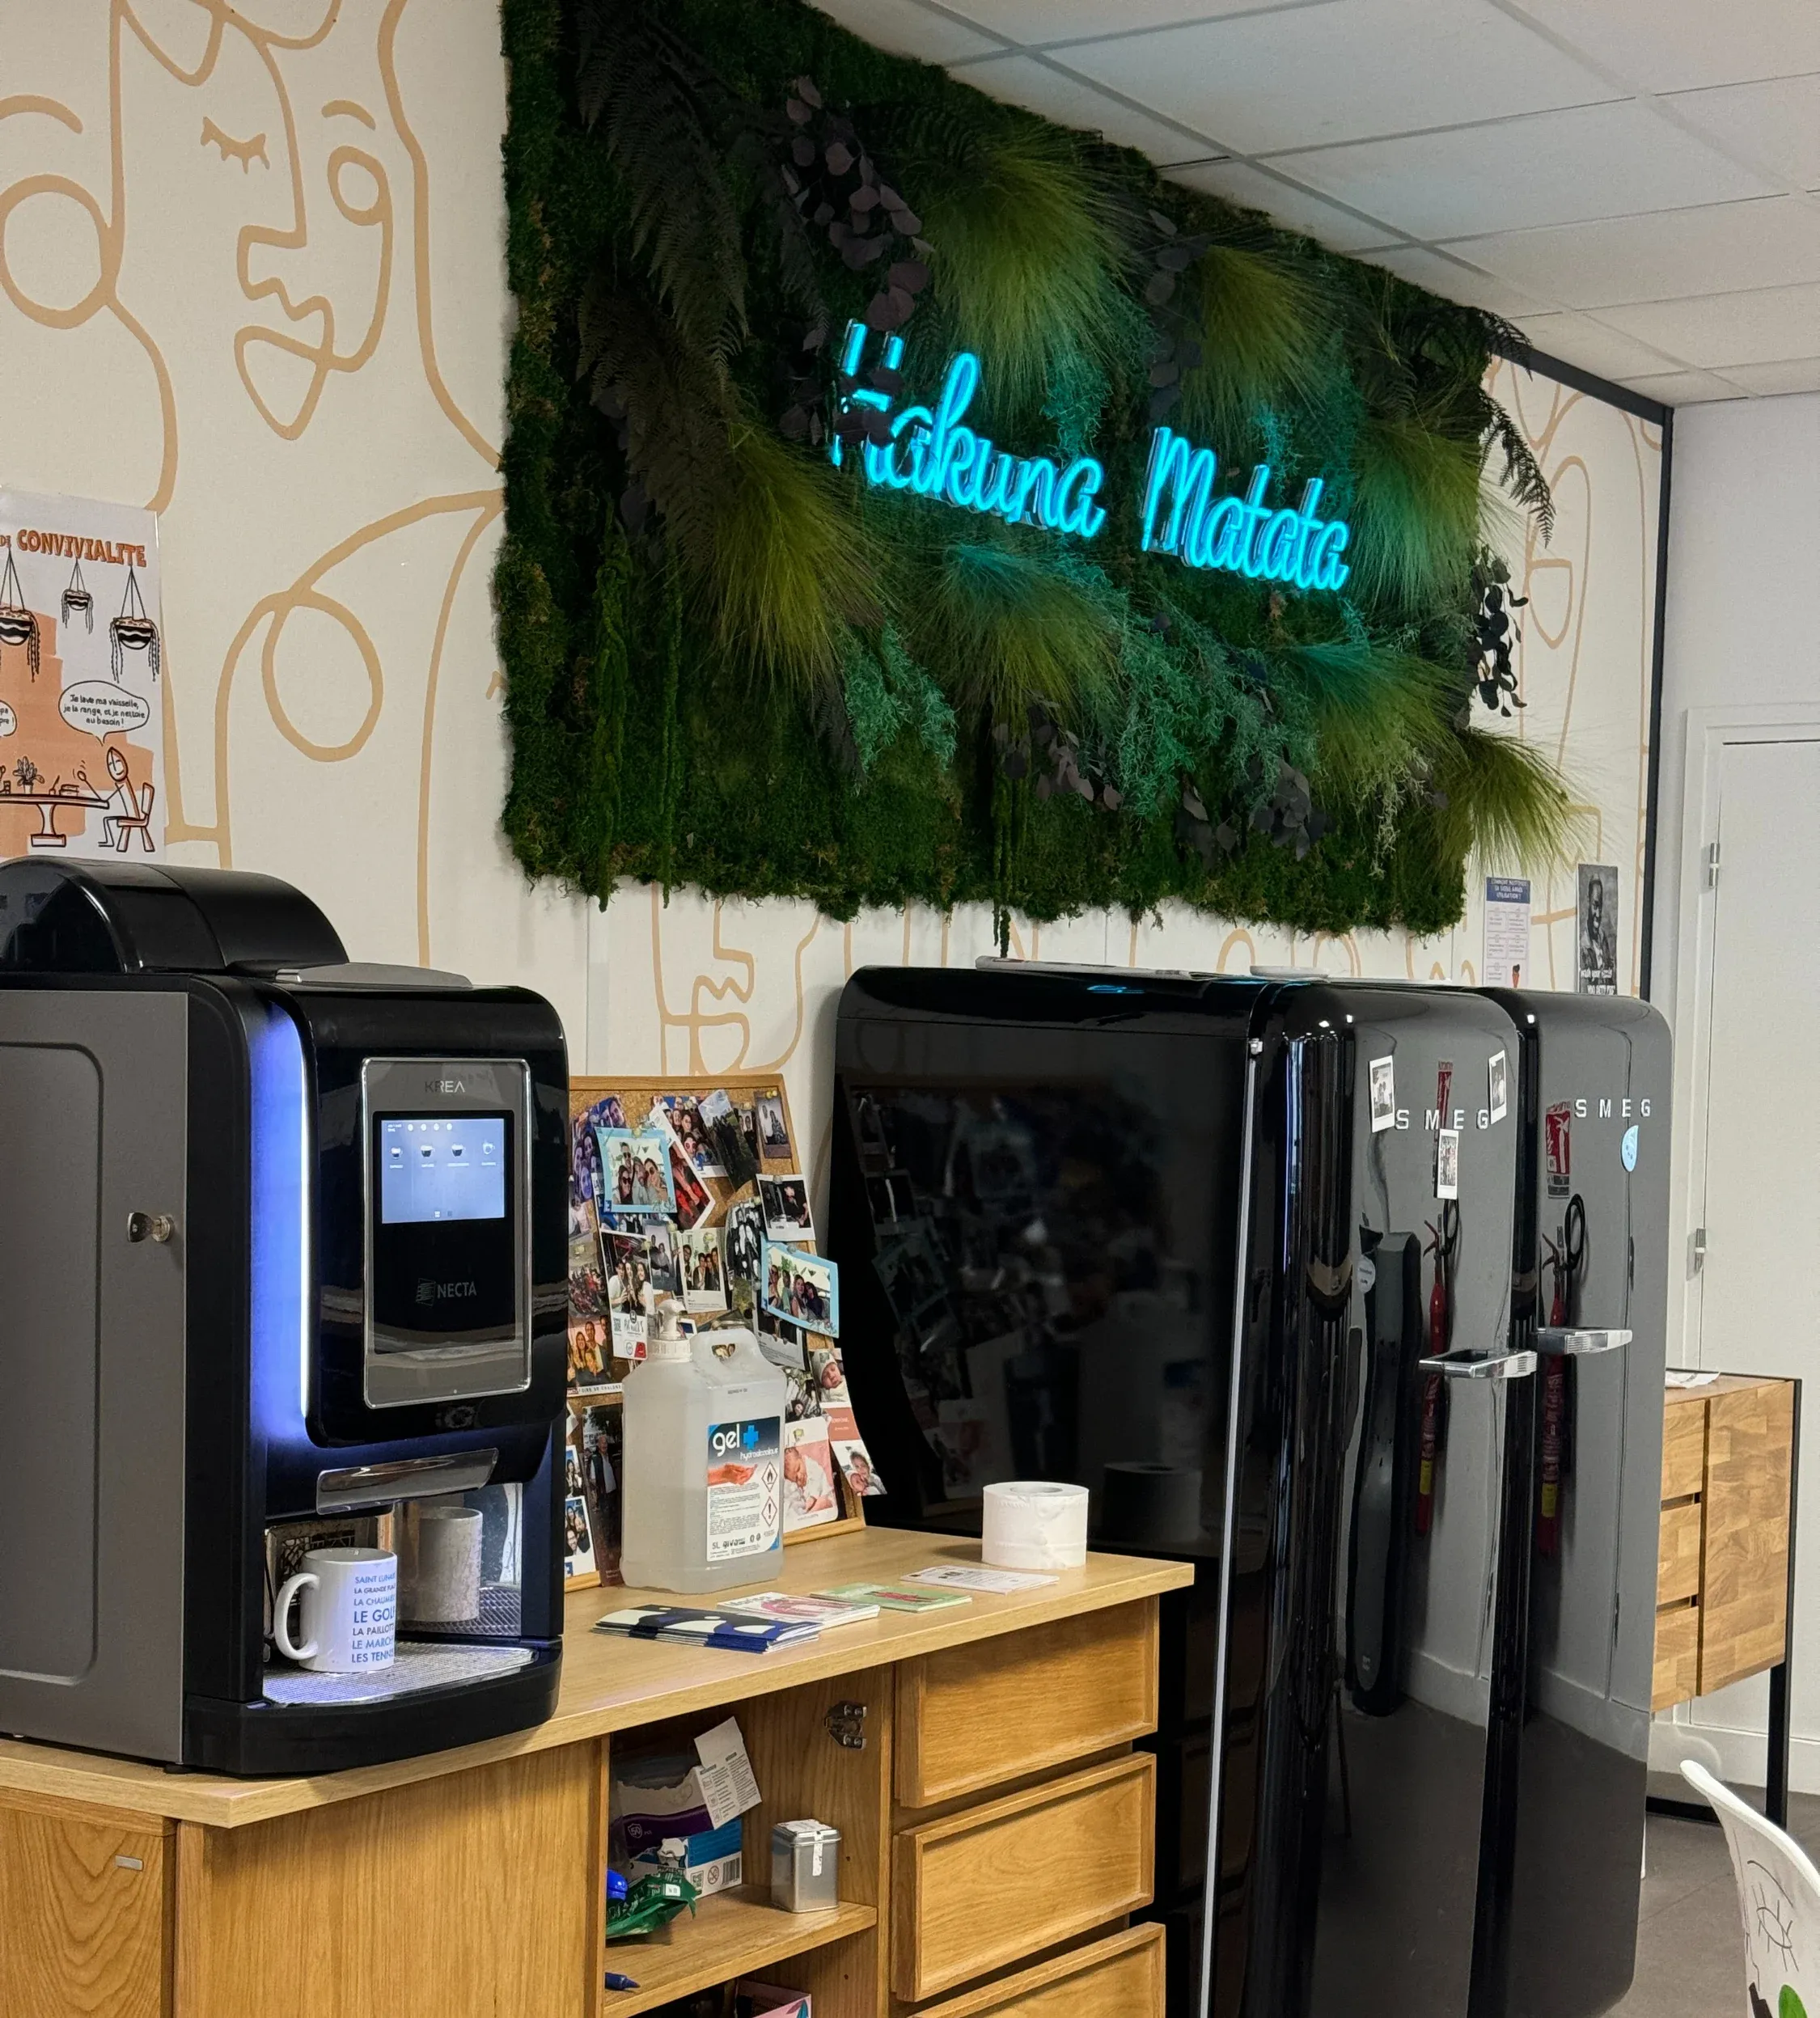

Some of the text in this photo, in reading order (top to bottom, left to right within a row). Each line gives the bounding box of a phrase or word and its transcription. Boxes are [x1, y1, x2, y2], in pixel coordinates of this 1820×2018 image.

[1141, 426, 1350, 590] Matata
[17, 529, 147, 568] CONVIVIALITE
[80, 695, 95, 704] lave
[425, 1080, 466, 1093] KREA
[437, 1281, 477, 1299] NECTA
[713, 1423, 740, 1457] gel
[355, 1576, 377, 1584] SAINT
[353, 1598, 364, 1606] LA
[353, 1610, 368, 1623] LE
[353, 1627, 364, 1636] LA
[352, 1640, 362, 1650] LE
[351, 1653, 368, 1663] LES
